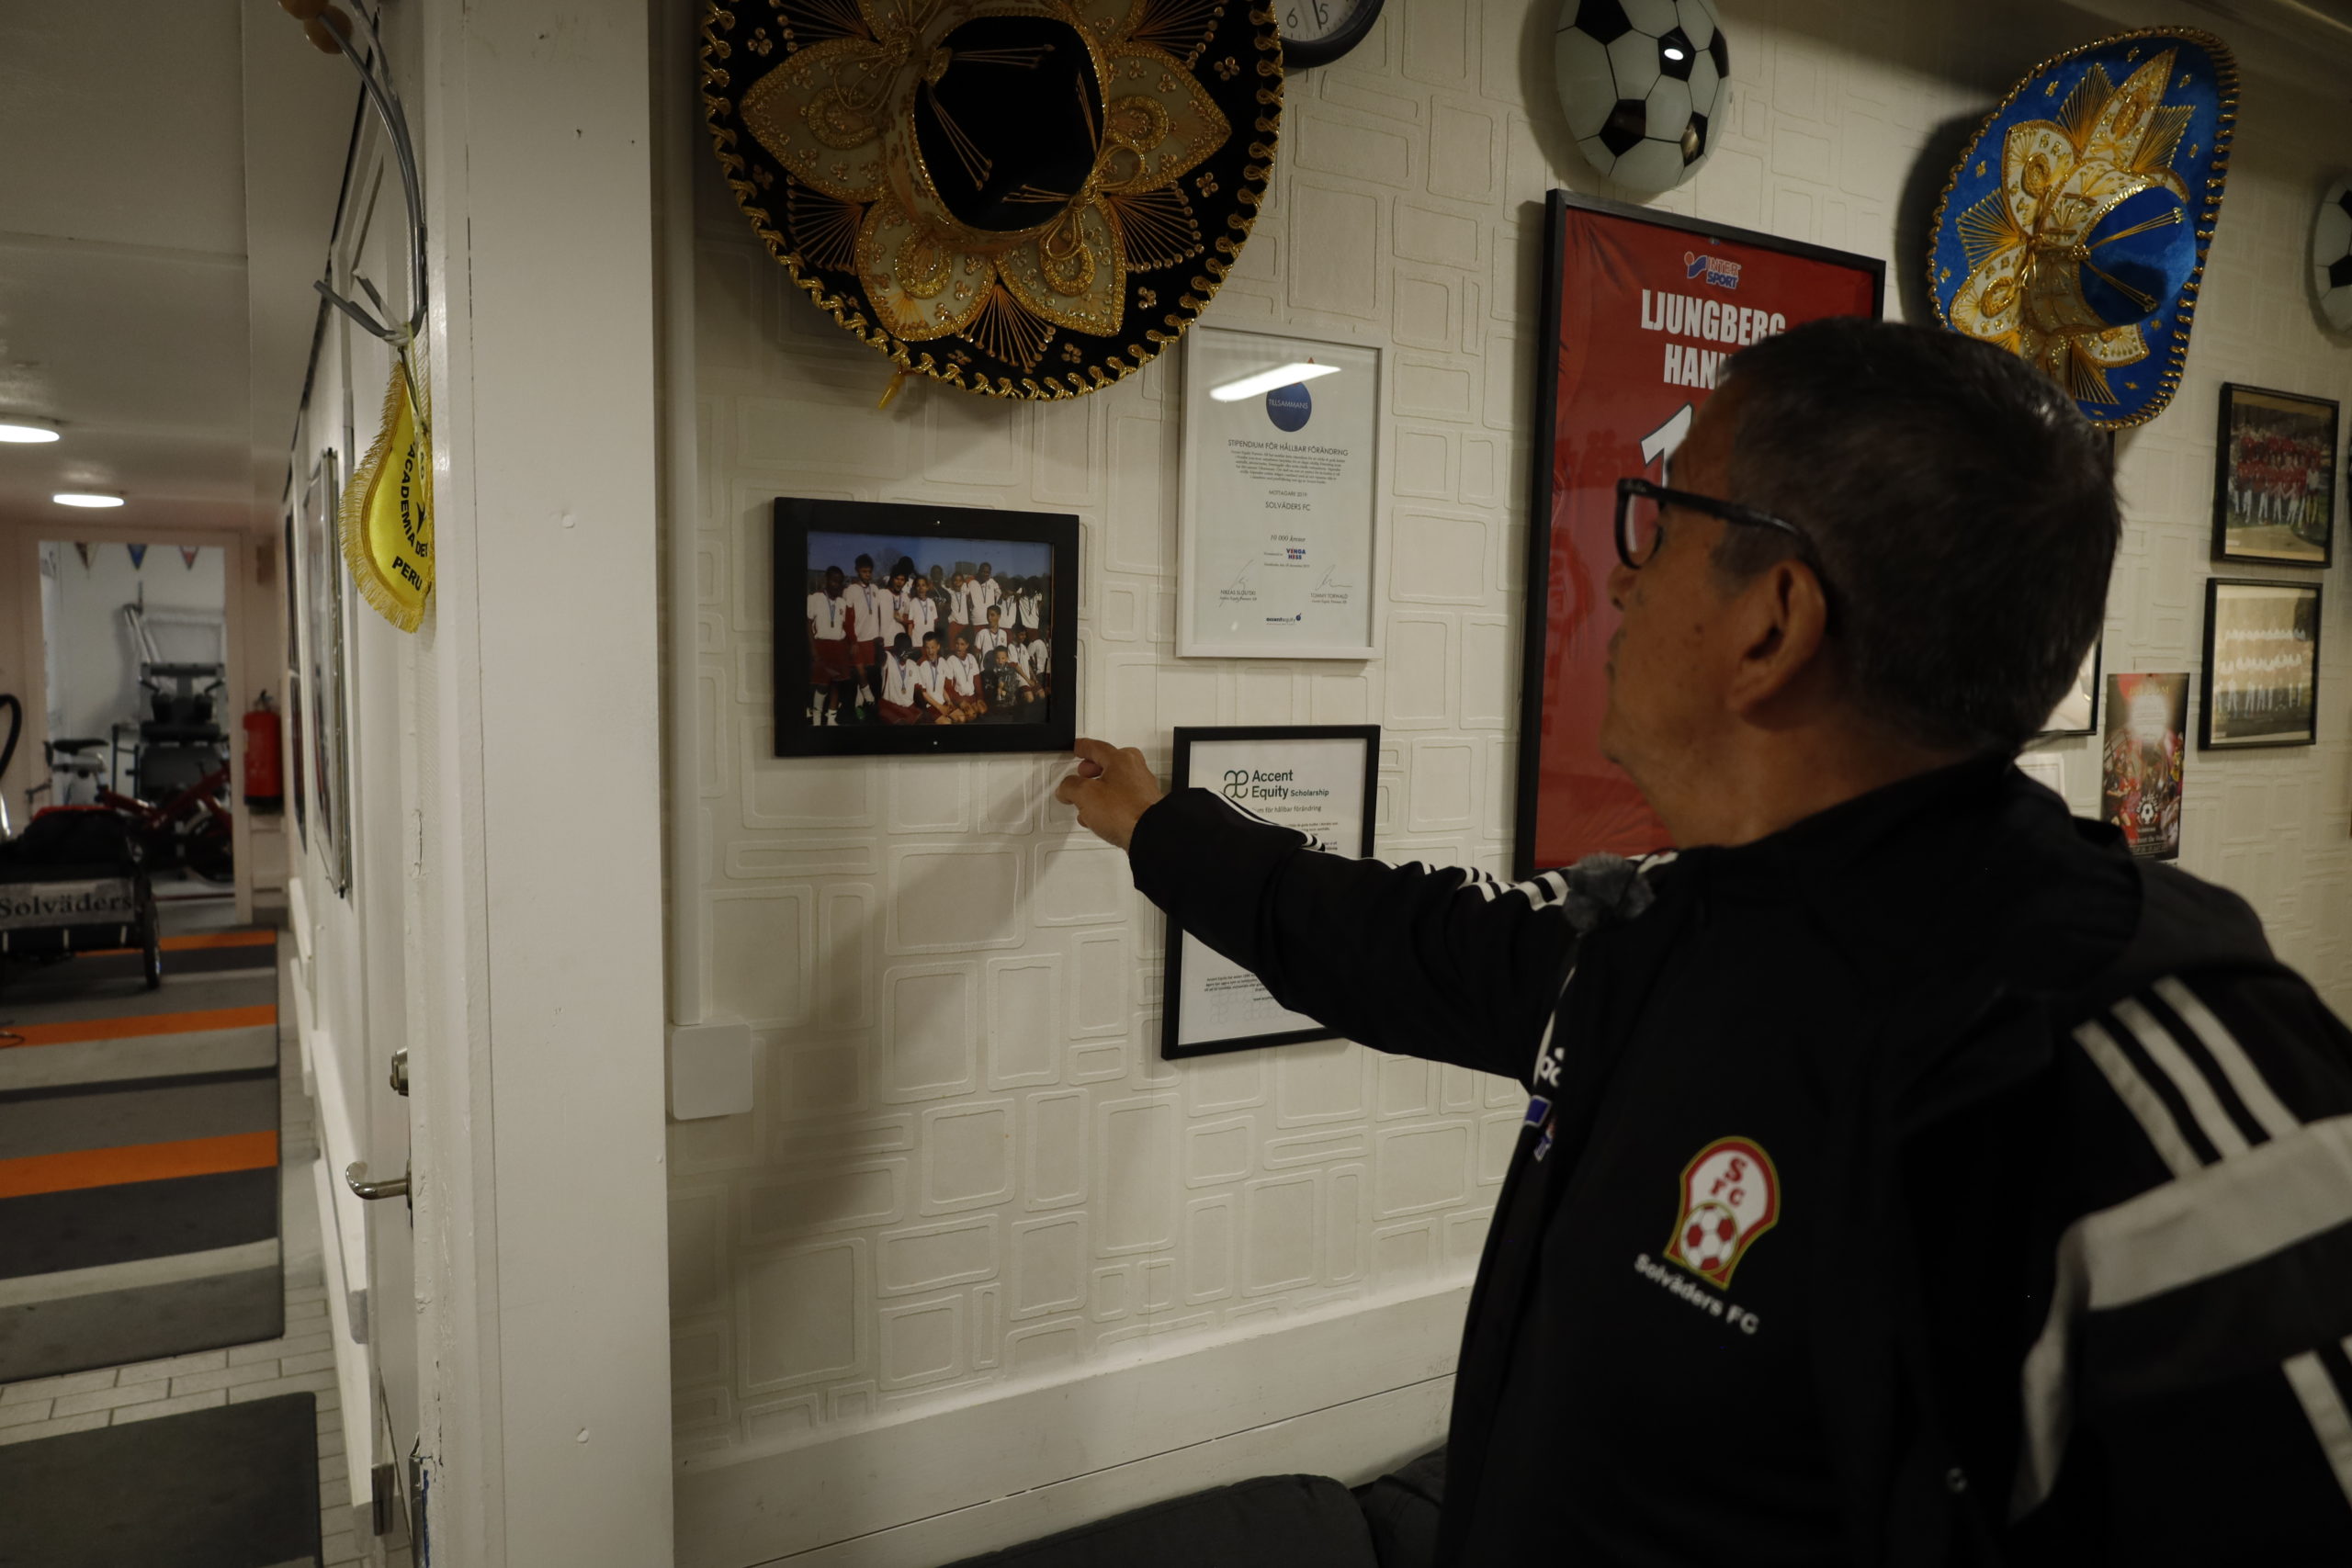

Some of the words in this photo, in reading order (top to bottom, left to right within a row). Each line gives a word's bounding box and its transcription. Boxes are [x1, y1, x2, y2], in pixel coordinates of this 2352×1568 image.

[1286, 7, 1298, 28] 6
[1708, 256, 1739, 276] INTER
[1708, 271, 1738, 288] SPORT
[1268, 399, 1308, 410] TILLSAMMANS
[1227, 439, 1264, 450] STIPENDIUM
[1265, 441, 1278, 450] FÖR
[1280, 442, 1306, 453] HÅLLBAR
[1307, 446, 1349, 457] FÖRÄNDRING
[400, 444, 416, 547] ACADEMIA
[1265, 502, 1302, 511] SOLVÄDERS
[1302, 503, 1311, 512] FC
[391, 556, 423, 592] PERU
[1251, 769, 1294, 783] Accent
[1251, 785, 1289, 800] Equity
[1290, 789, 1329, 797] Scholarship
[1294, 805, 1322, 813] förändring
[0, 892, 133, 918] Solväders
[1725, 1303, 1760, 1335] FC
